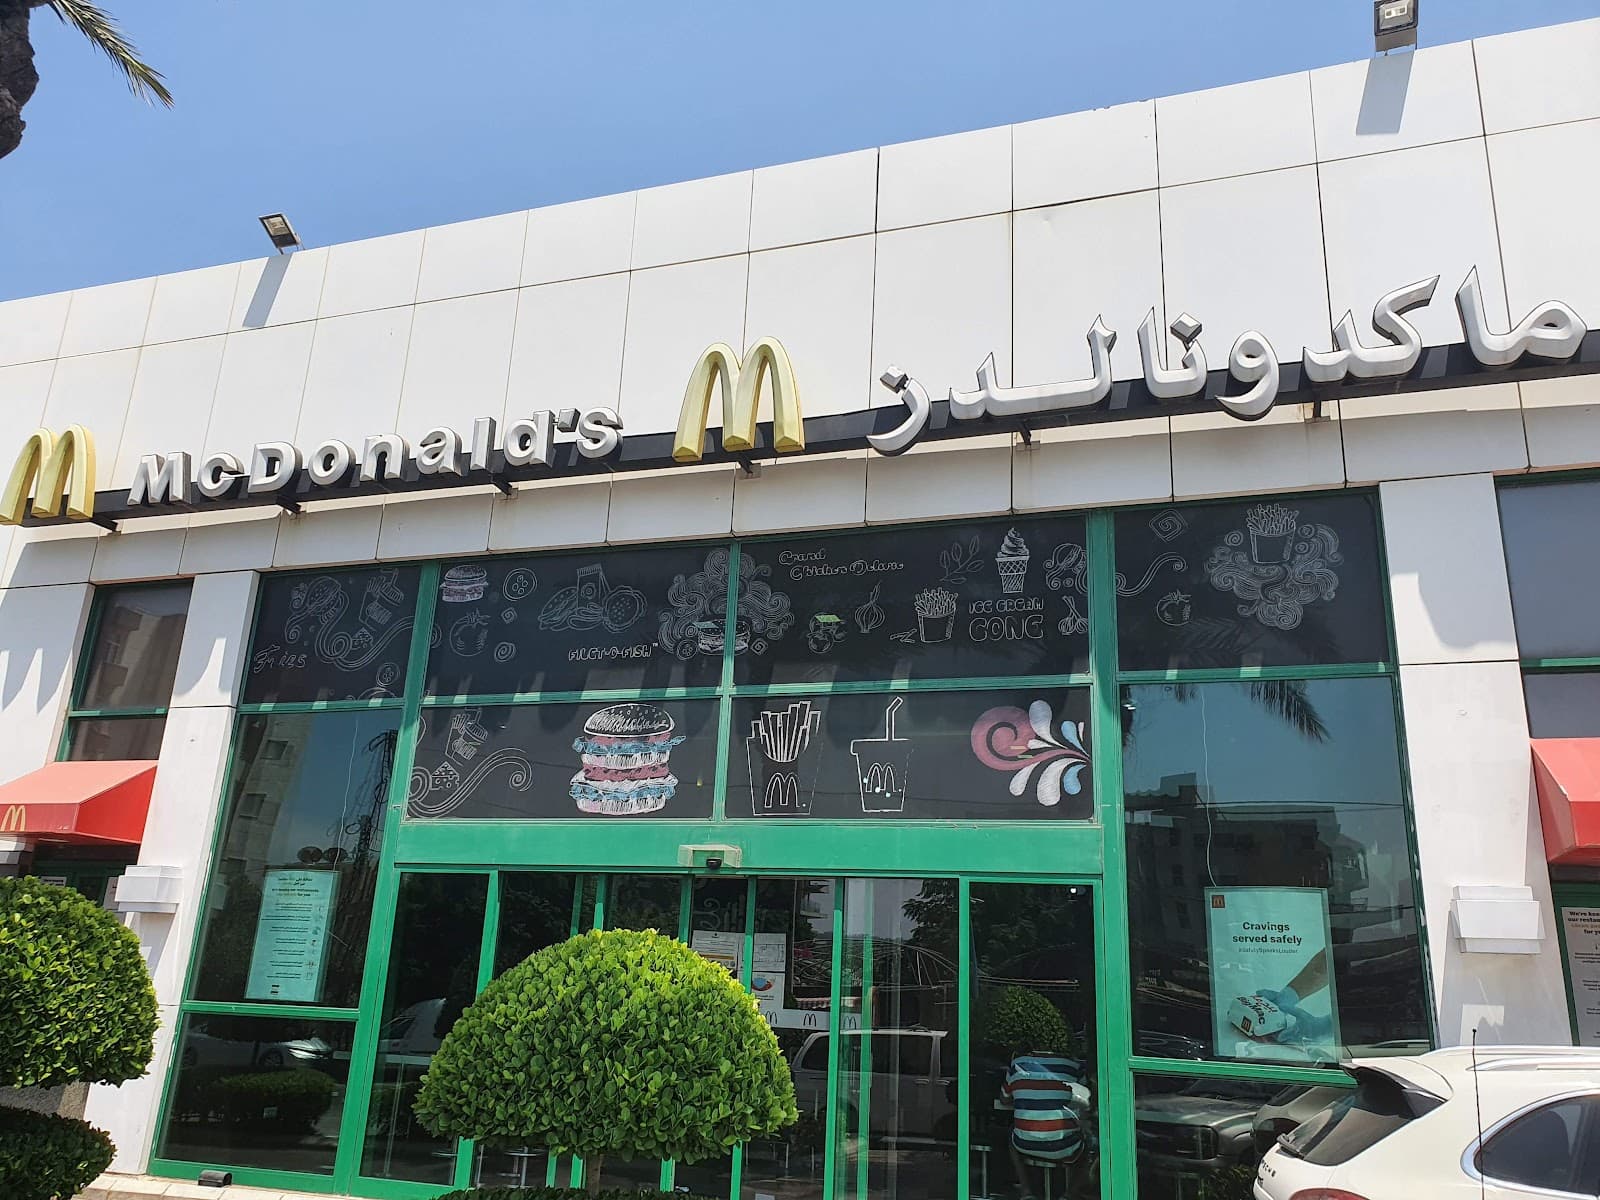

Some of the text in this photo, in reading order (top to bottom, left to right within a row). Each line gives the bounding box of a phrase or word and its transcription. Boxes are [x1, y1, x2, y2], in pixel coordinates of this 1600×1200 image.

[866, 264, 1587, 457] ماكدونالدز
[127, 406, 624, 505] McDonald's
[969, 614, 1044, 642] CONE
[1232, 934, 1302, 946] served safely
[1242, 921, 1290, 933] Cravings
